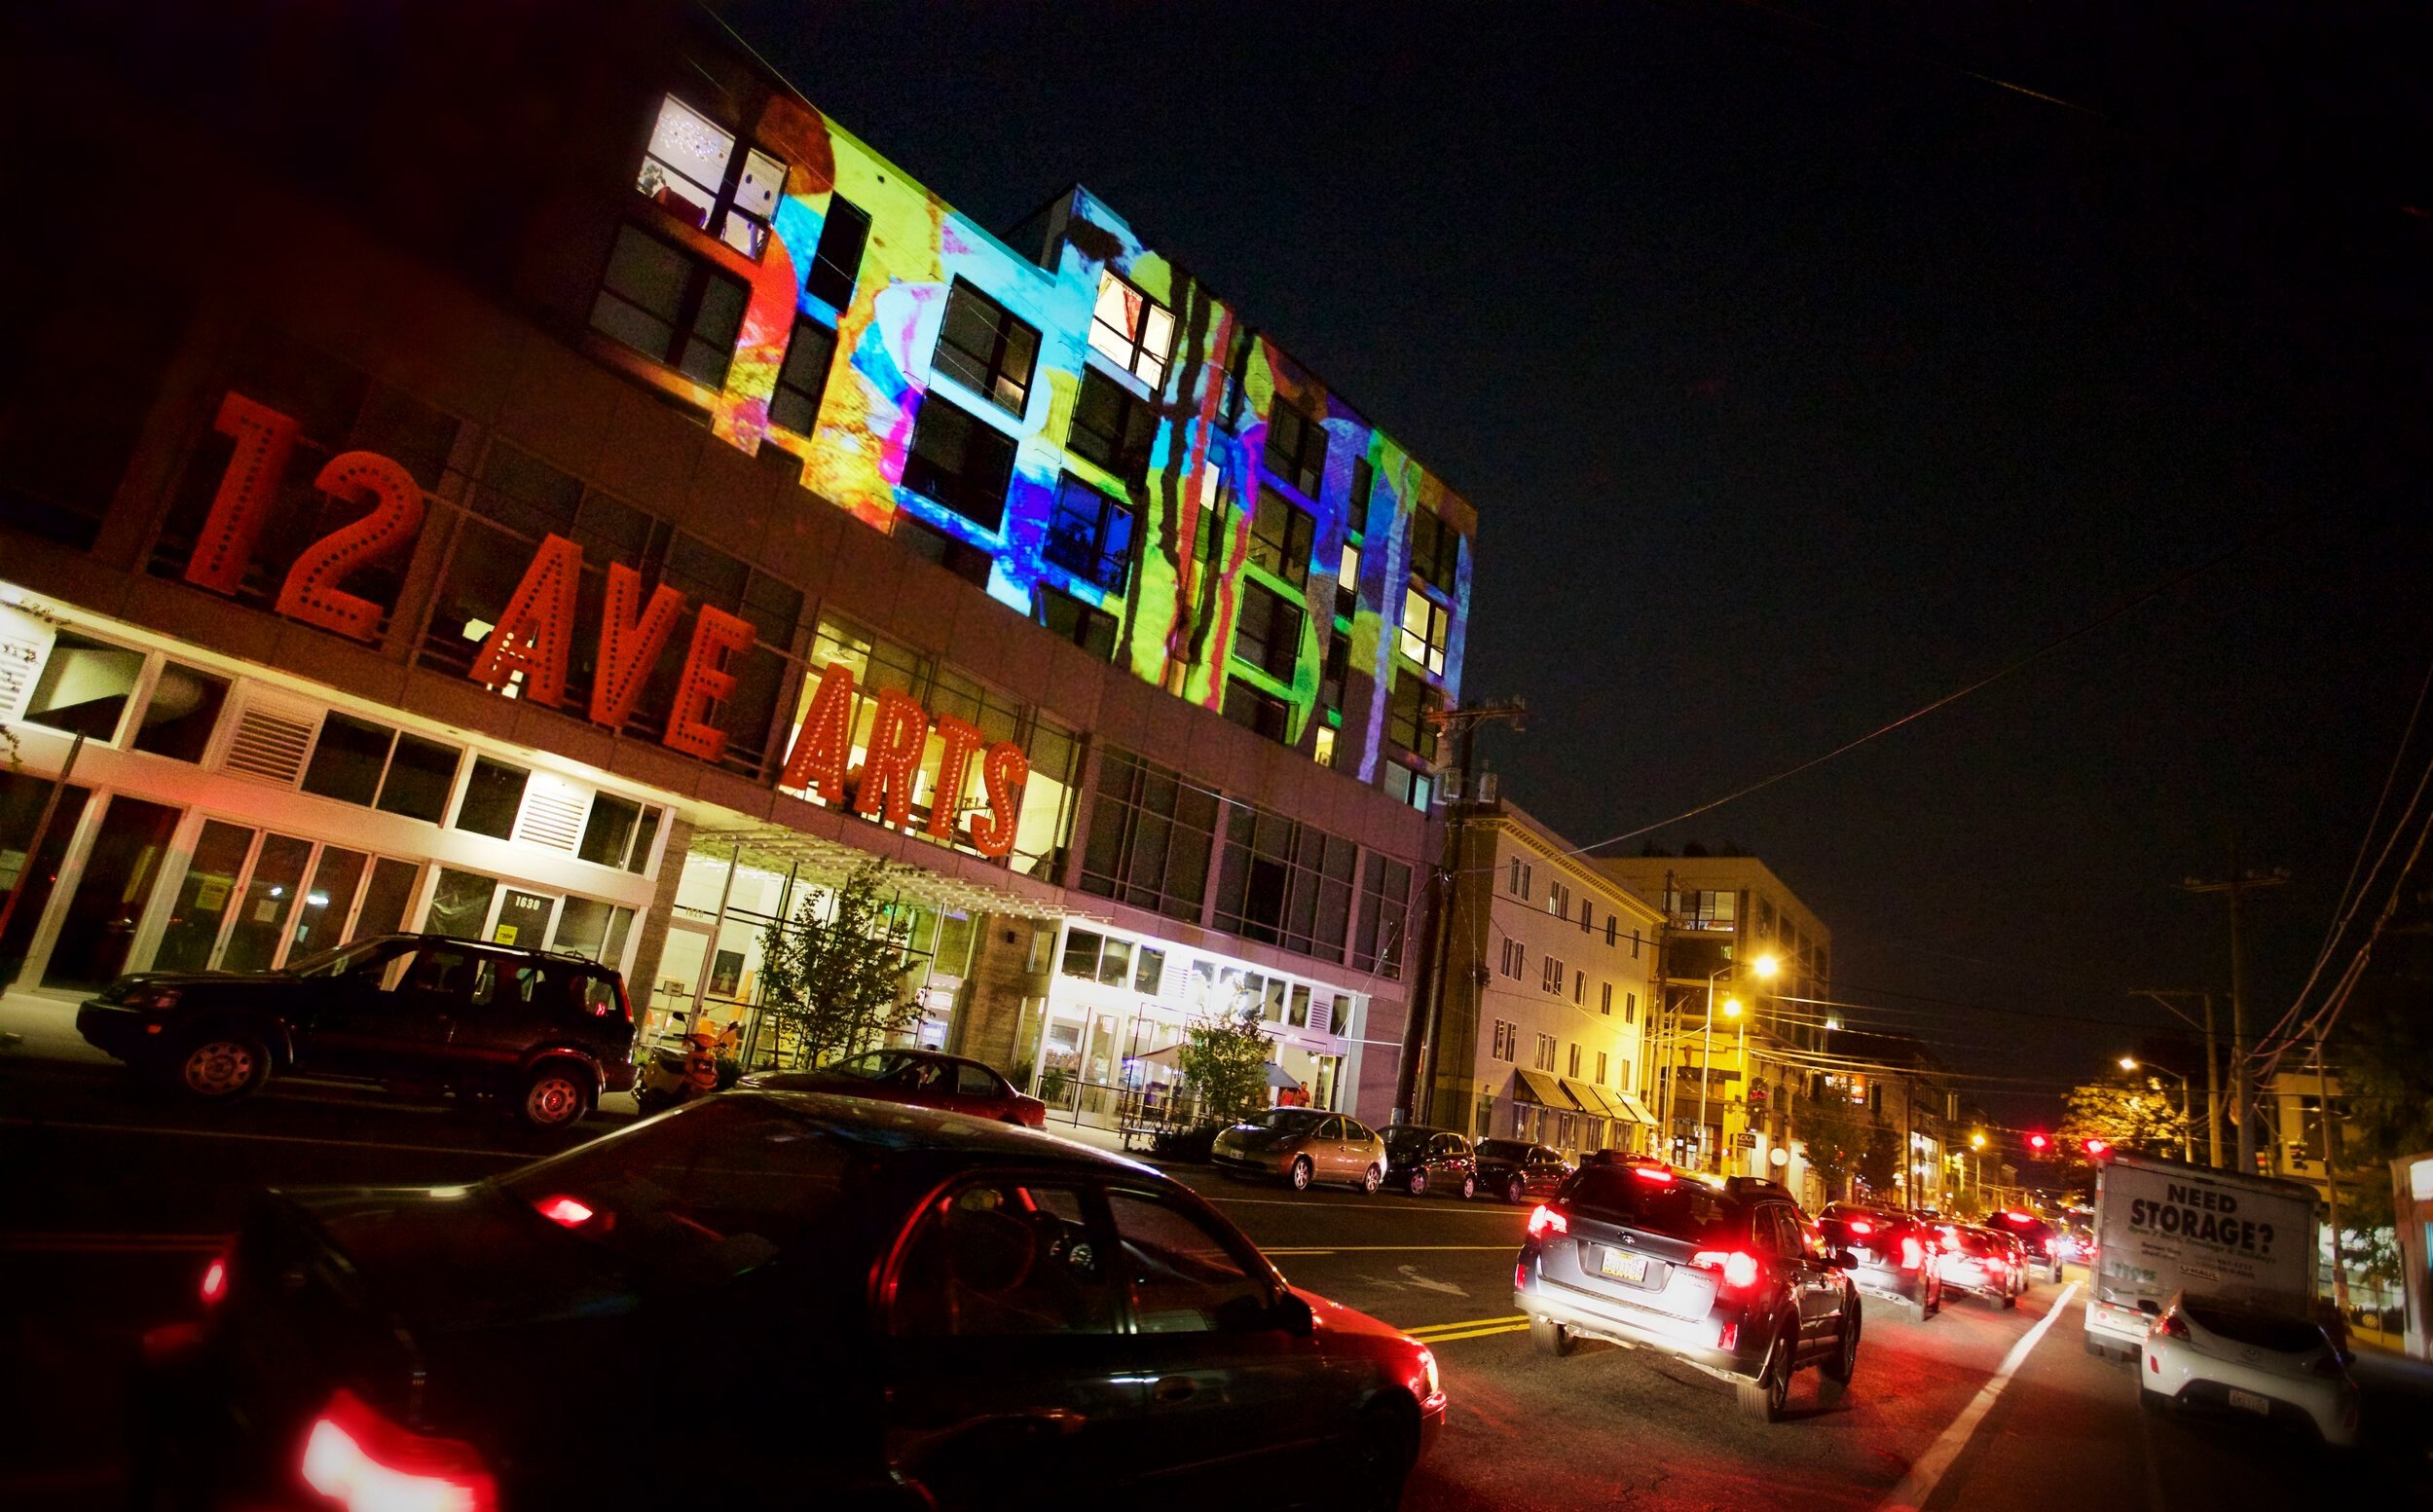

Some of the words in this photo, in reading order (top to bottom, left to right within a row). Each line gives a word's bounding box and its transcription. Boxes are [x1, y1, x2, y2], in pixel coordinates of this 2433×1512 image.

[183, 390, 425, 644] 12
[468, 532, 756, 764] AVE
[782, 661, 1029, 858] ARTS
[515, 896, 540, 911] 1630
[2167, 1183, 2237, 1214] NEED
[2130, 1198, 2274, 1254] STORAGE?
